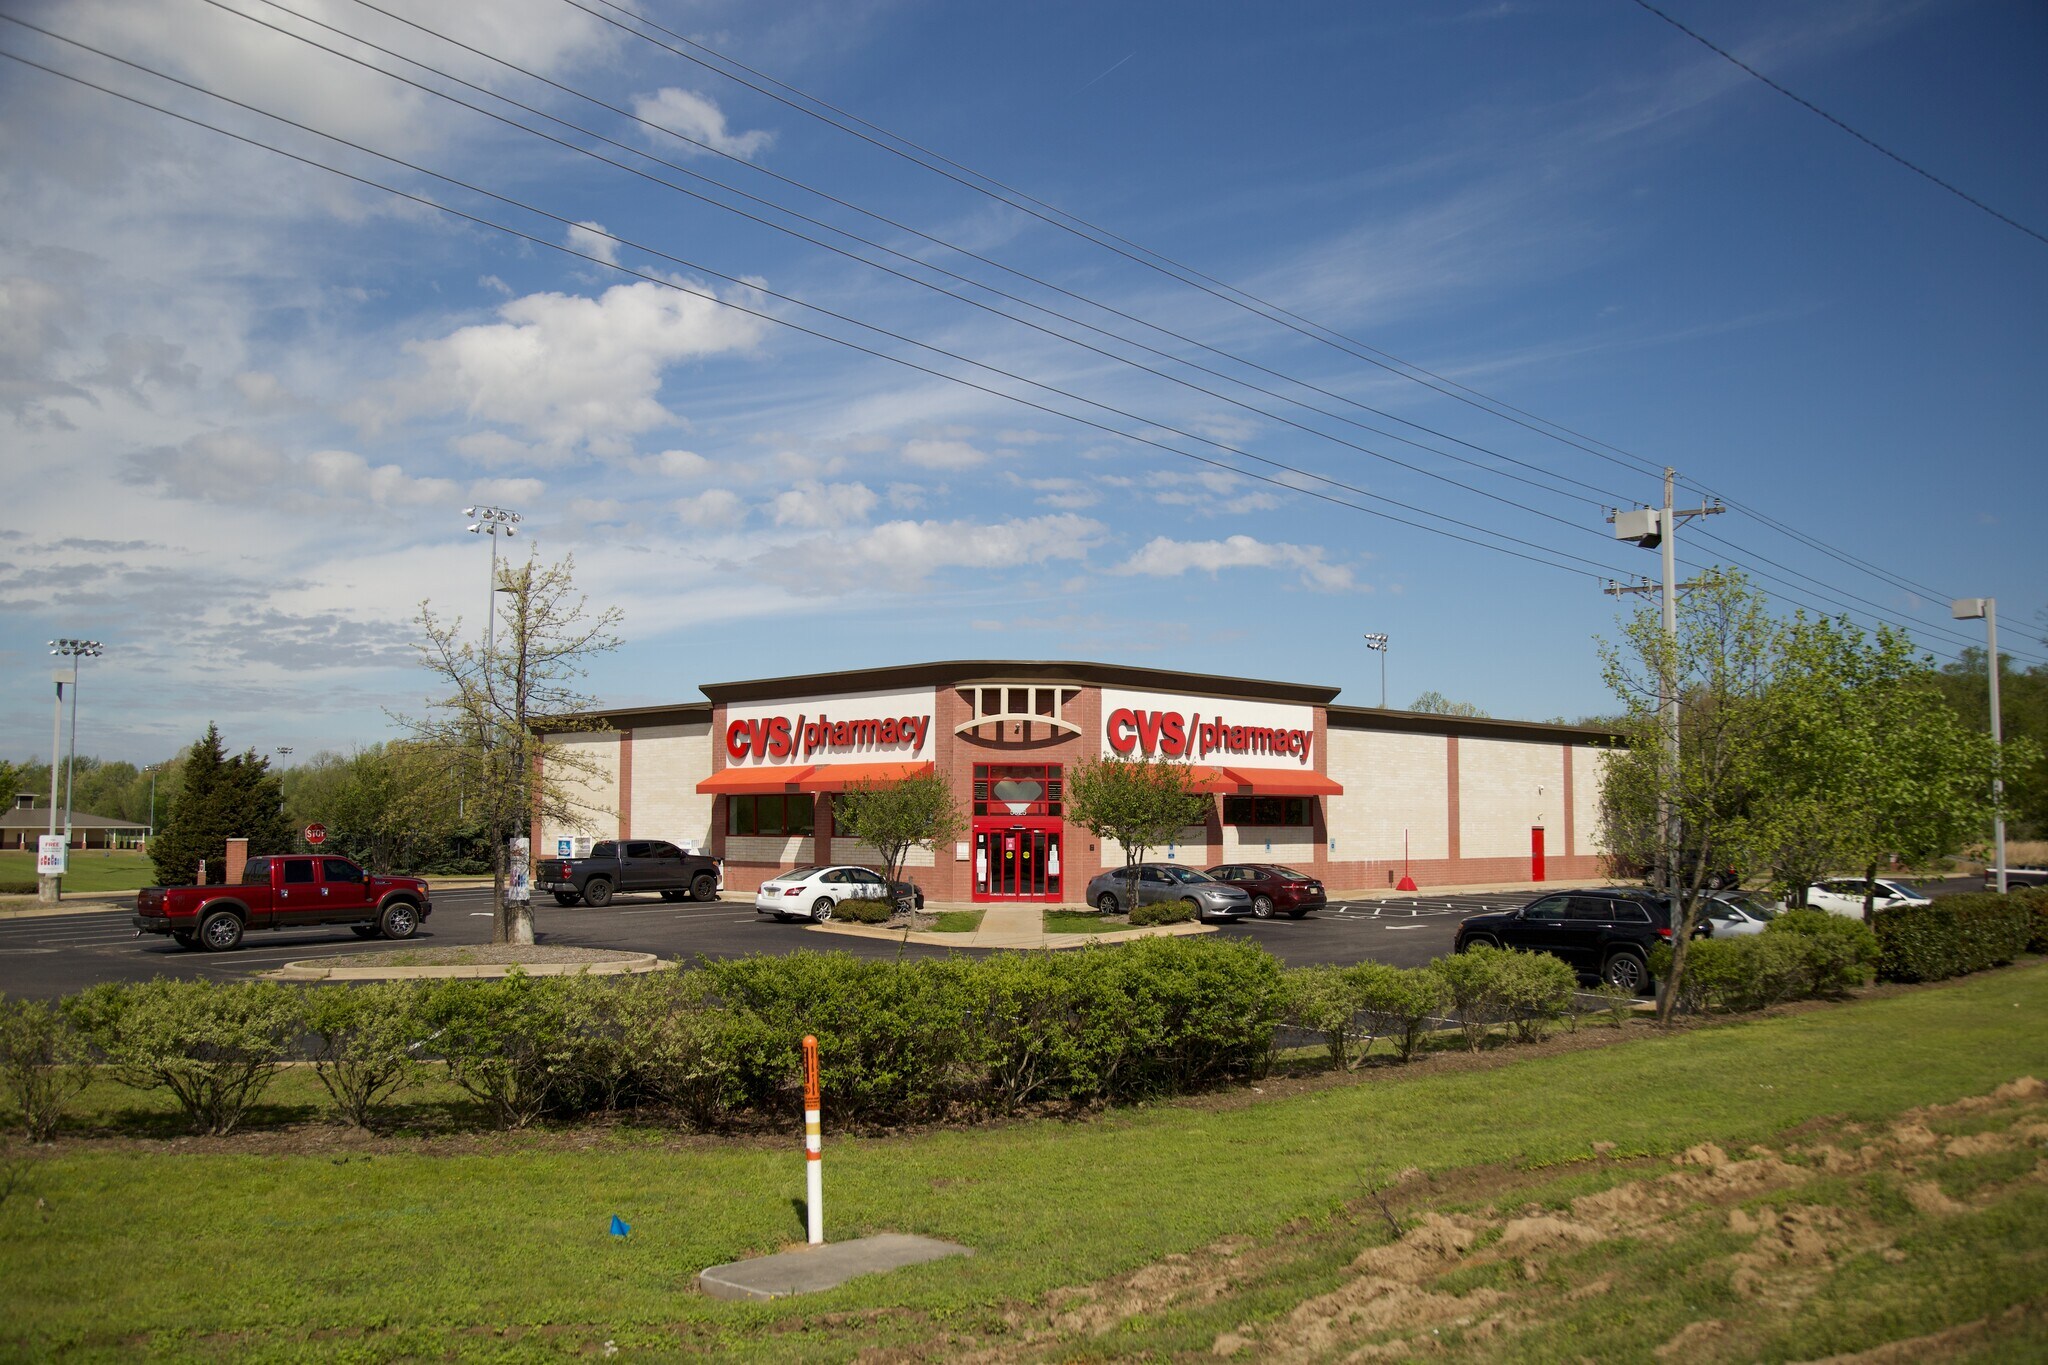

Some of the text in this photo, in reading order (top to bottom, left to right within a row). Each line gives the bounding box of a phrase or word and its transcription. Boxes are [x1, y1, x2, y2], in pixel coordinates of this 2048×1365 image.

[726, 714, 930, 758] CVS/pharmacy
[1107, 707, 1313, 762] CVS/pharmacy
[306, 829, 326, 838] STOP
